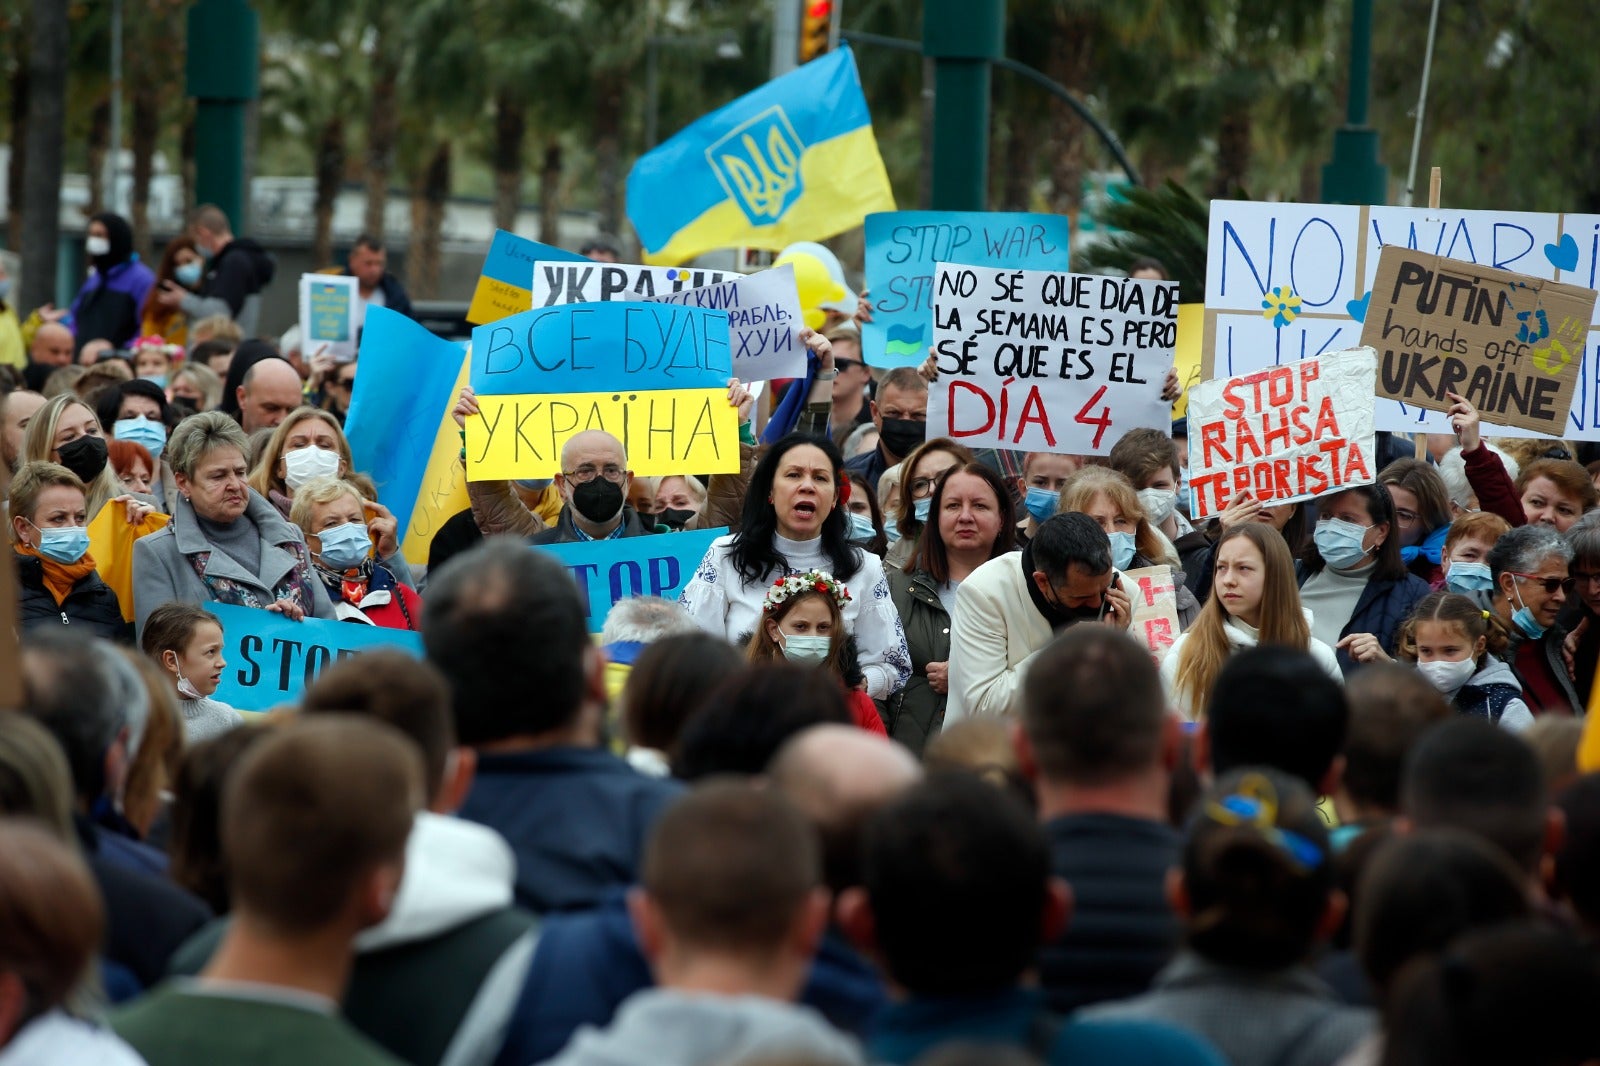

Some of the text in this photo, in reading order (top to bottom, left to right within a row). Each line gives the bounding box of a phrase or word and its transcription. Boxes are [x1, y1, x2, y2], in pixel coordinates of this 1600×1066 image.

[886, 223, 1057, 264] STOP WAR
[1220, 217, 1344, 307] NO
[938, 270, 1180, 319] NO SÉ QUE DÍA DE
[485, 308, 728, 378] ВСЕ БУДЕ
[735, 322, 792, 358] ХУЙ
[935, 304, 1178, 349] LA SEMANA ES PERO
[1381, 307, 1468, 355] hands
[1484, 339, 1531, 366] off
[936, 335, 979, 376] SÉ
[993, 342, 1049, 379] QUE
[1059, 347, 1095, 381] ES
[1108, 352, 1147, 385] EL
[948, 376, 1113, 450] DÍA 4
[1222, 360, 1320, 420] STOP
[1201, 396, 1341, 469] RAHSA
[237, 634, 362, 692] STO
